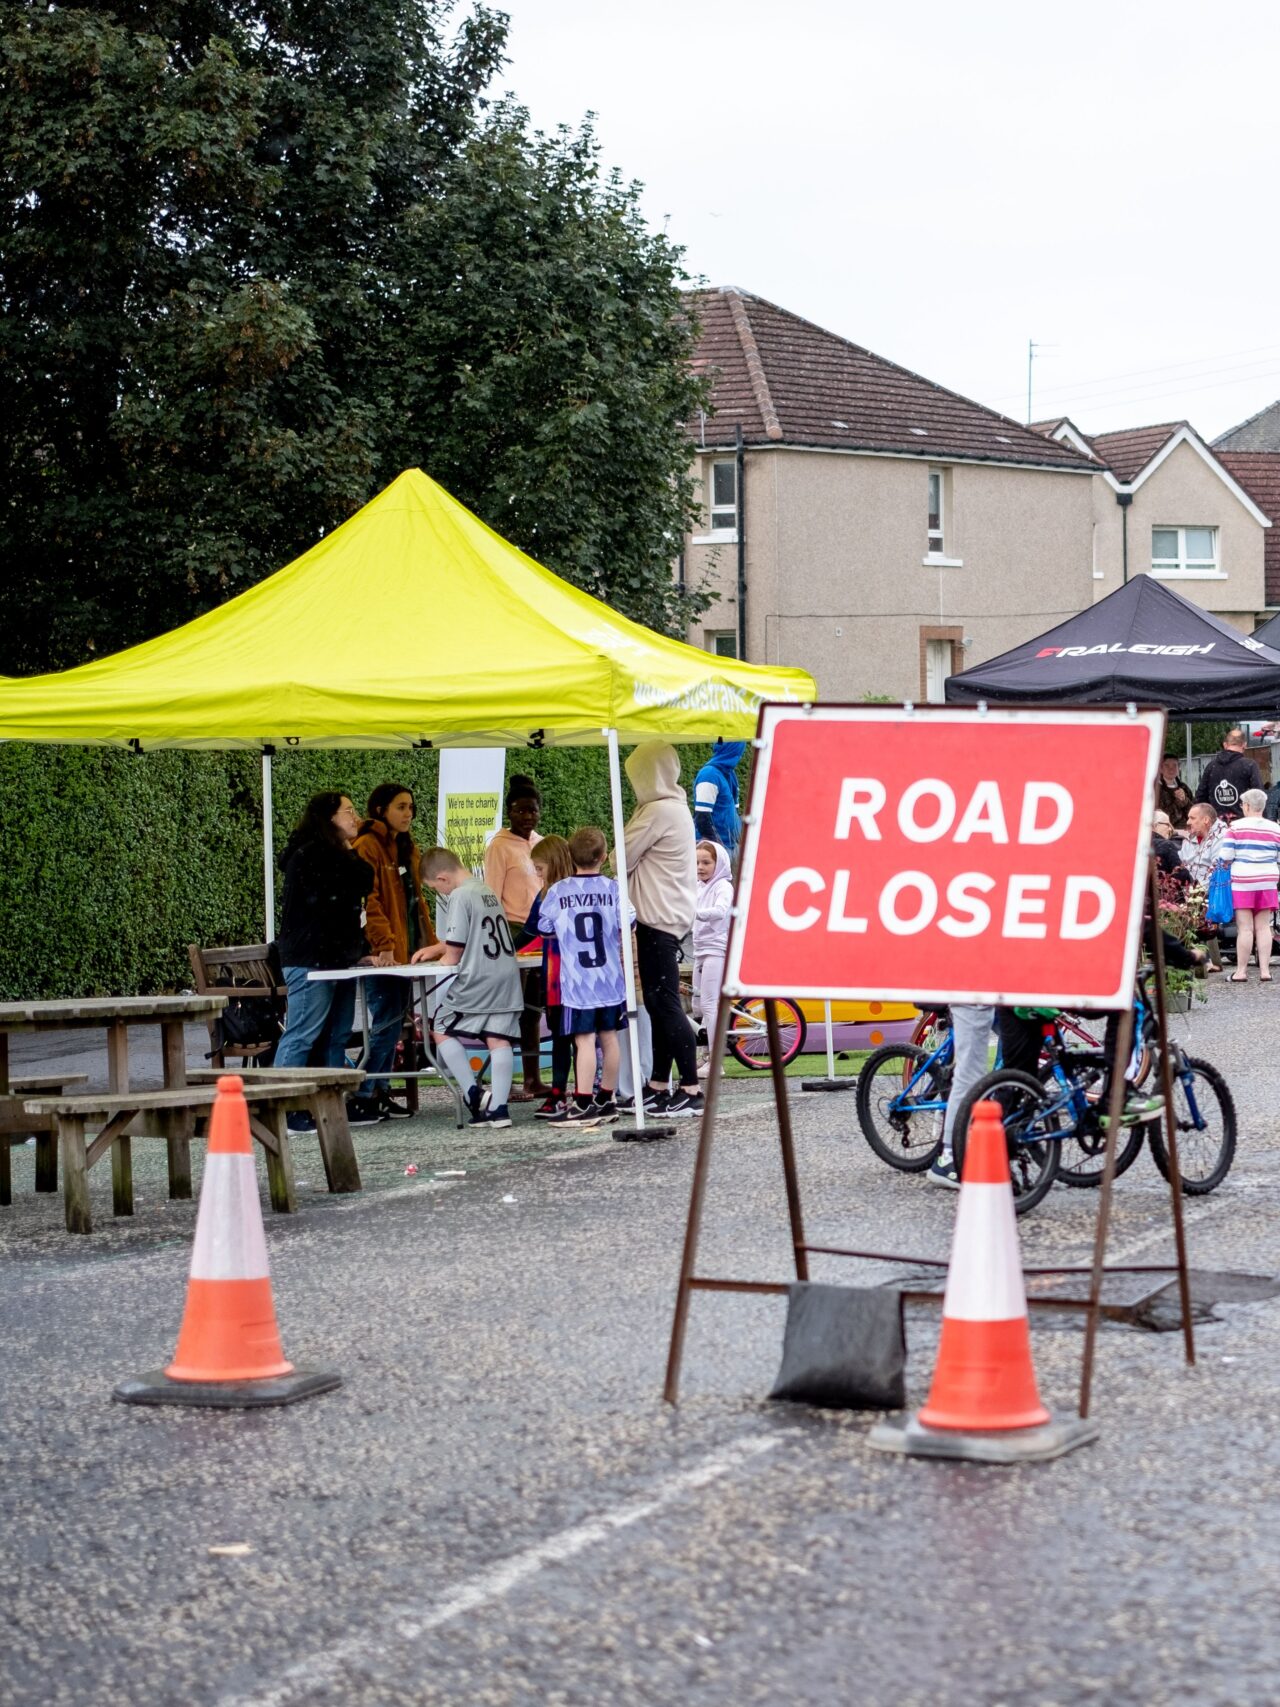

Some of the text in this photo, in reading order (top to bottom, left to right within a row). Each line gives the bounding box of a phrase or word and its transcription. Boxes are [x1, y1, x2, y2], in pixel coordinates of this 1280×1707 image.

[1056, 642, 1217, 658] RALEIGH
[447, 797, 499, 810] We're the charity
[834, 777, 1074, 845] ROAD
[474, 816, 495, 826] easier
[559, 893, 613, 909] BENZEMA
[768, 866, 1117, 939] CLOSED
[481, 914, 515, 960] 30
[574, 912, 607, 969] 9
